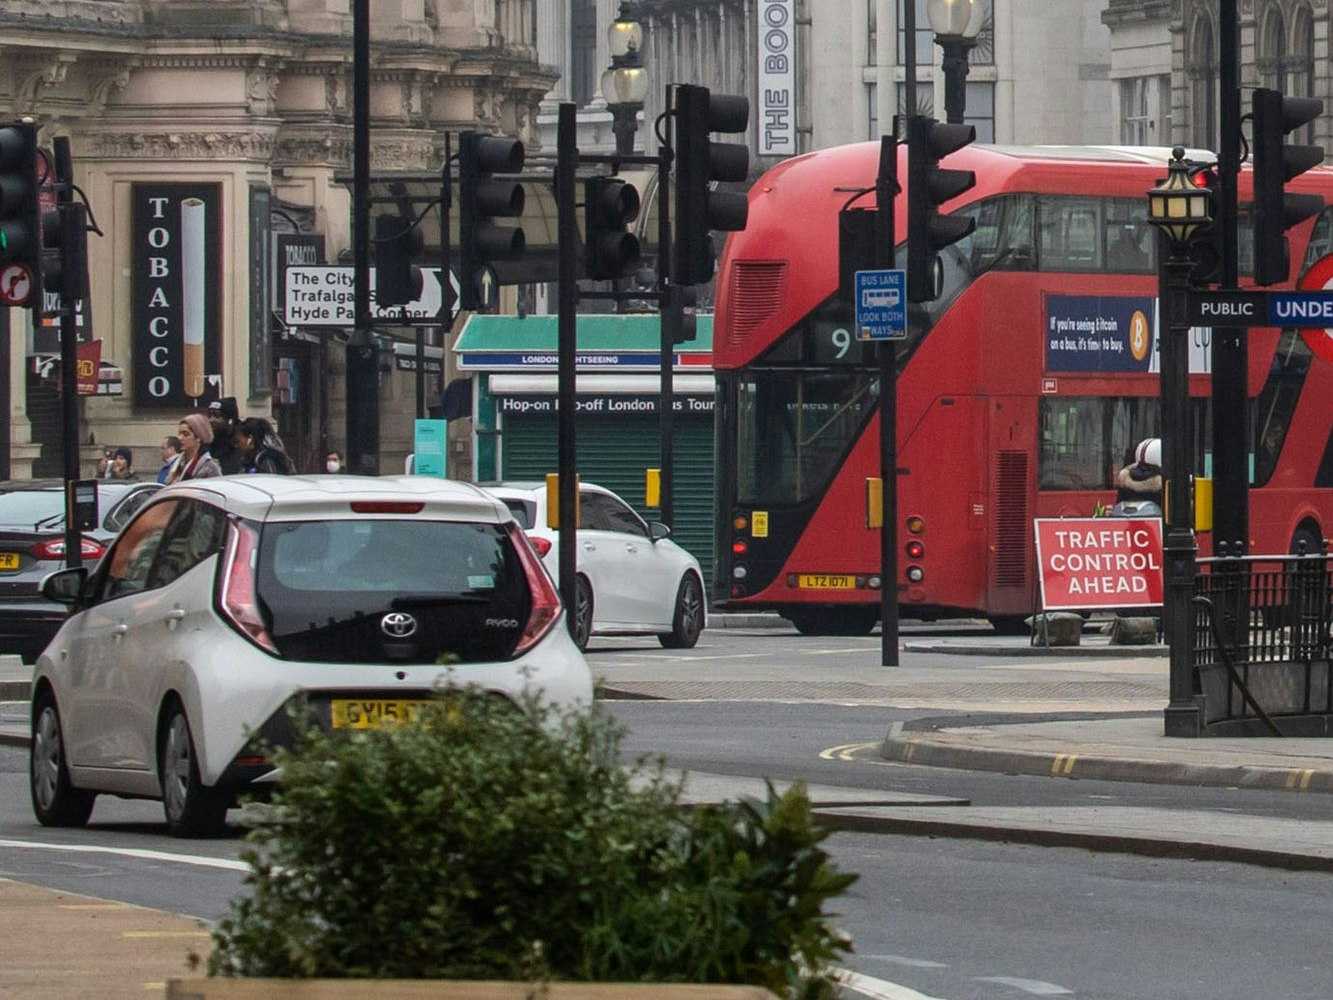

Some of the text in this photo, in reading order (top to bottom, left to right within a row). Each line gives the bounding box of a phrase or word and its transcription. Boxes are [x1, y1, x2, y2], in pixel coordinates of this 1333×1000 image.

[765, 88, 790, 151] THE
[292, 272, 355, 287] The City
[861, 275, 899, 286] BUS LANE
[148, 197, 170, 397] TOBACCO
[292, 289, 355, 303] Trafalga
[291, 306, 330, 321] Hyde
[336, 306, 355, 319] Pa
[1201, 302, 1254, 316] PUBLIC
[859, 311, 903, 323] LOOK BOTH
[1050, 316, 1057, 330] If
[831, 328, 850, 359] 9
[1050, 339, 1059, 350] on
[1102, 339, 1109, 350] to
[522, 356, 618, 364] LONDON HTSEEING
[503, 398, 550, 412] Hop-on
[608, 398, 655, 411] London
[1055, 530, 1149, 548] TRAFFIC
[1050, 553, 1160, 572] CONTROL
[806, 576, 848, 587] LTZ 1071
[1068, 576, 1147, 594] AHEAD
[485, 617, 519, 628] AYGO
